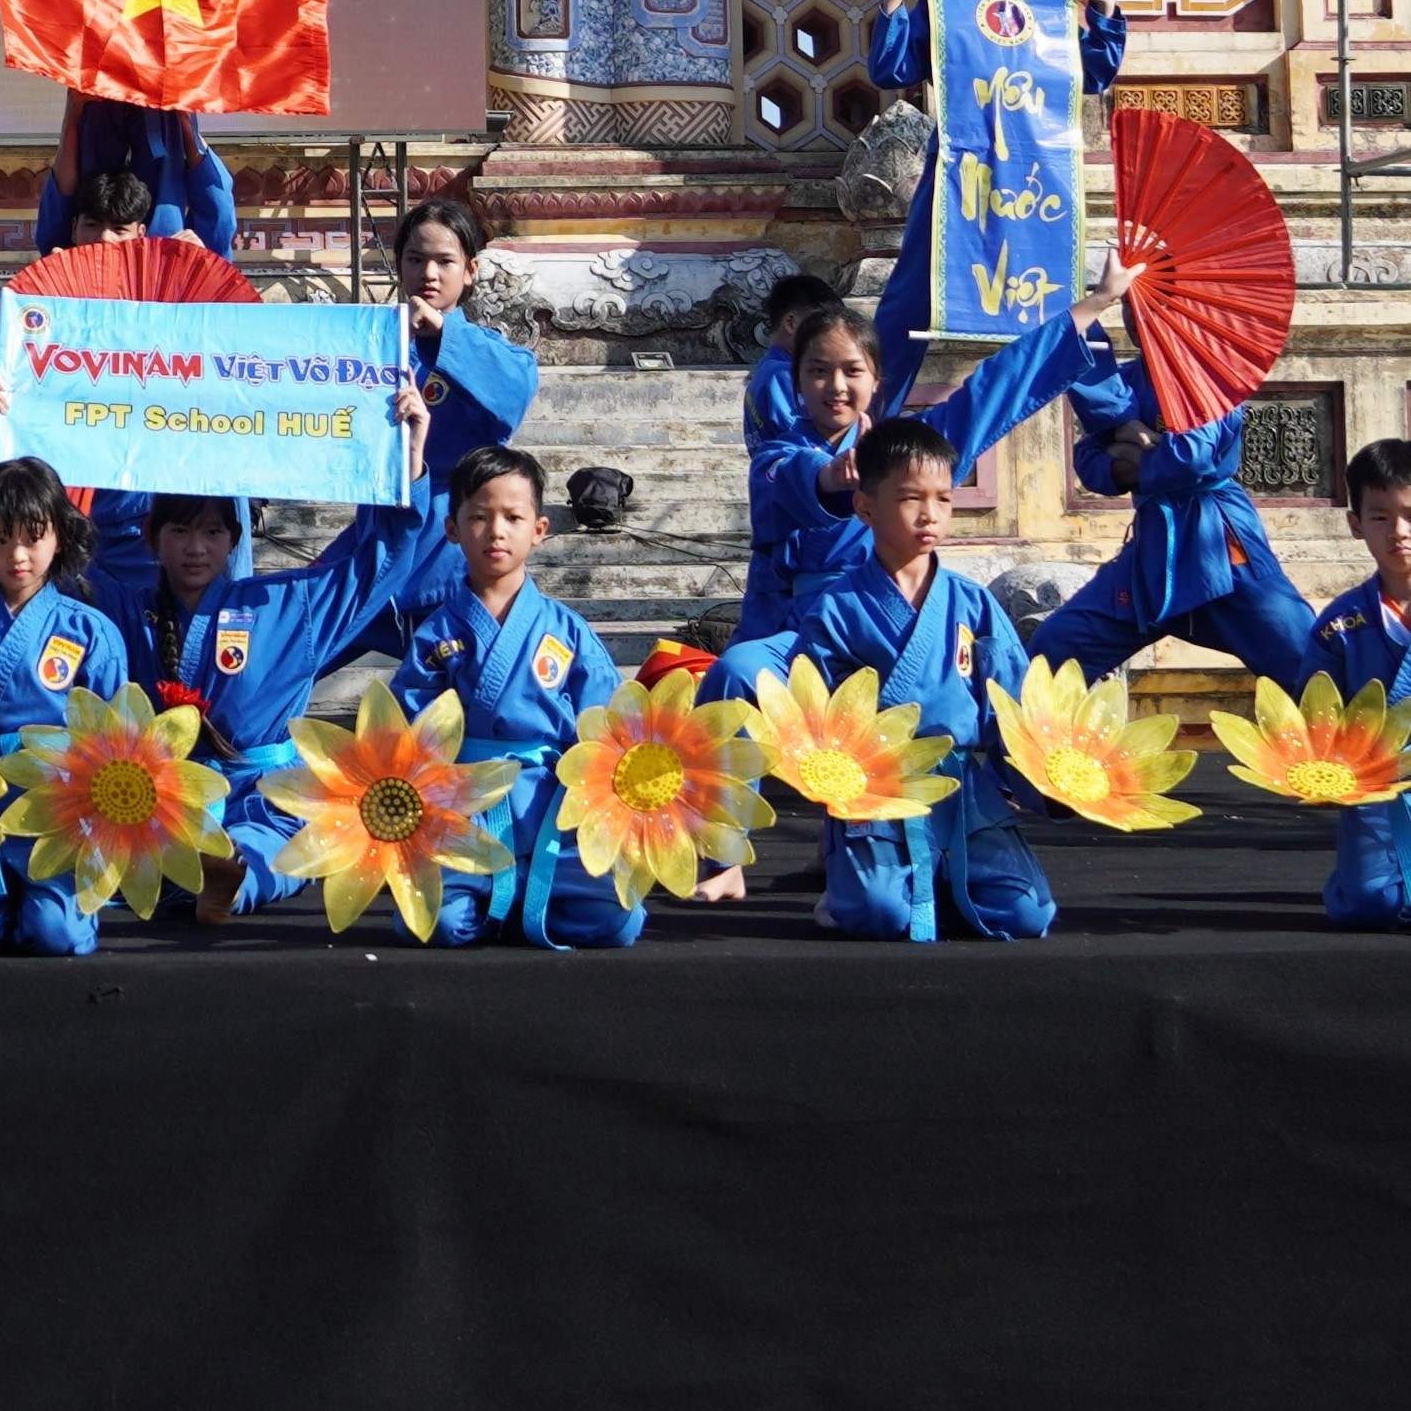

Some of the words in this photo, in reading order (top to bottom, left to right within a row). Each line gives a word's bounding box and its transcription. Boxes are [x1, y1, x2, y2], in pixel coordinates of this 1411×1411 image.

[972, 236, 1064, 324] Việt
[23, 340, 204, 389] VOVINAM
[65, 401, 132, 428] FPT
[144, 405, 264, 435] School
[278, 406, 357, 438] HUẾ
[1320, 613, 1367, 640] KHOA
